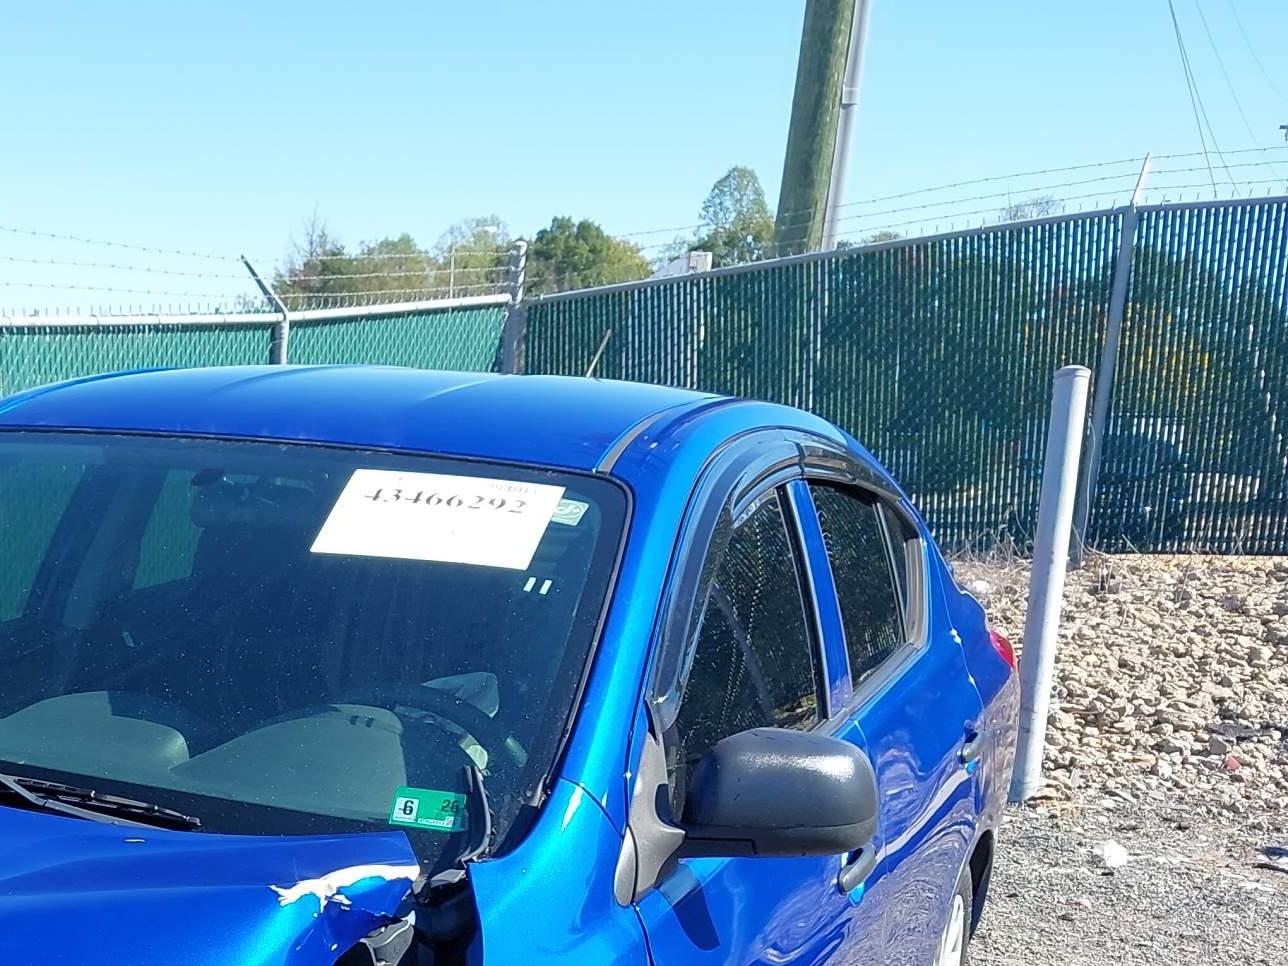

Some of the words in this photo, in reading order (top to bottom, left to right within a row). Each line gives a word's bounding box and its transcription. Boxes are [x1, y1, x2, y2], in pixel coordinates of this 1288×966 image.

[364, 487, 528, 514] 43466292
[403, 800, 414, 816] 6
[441, 799, 460, 813] 26
